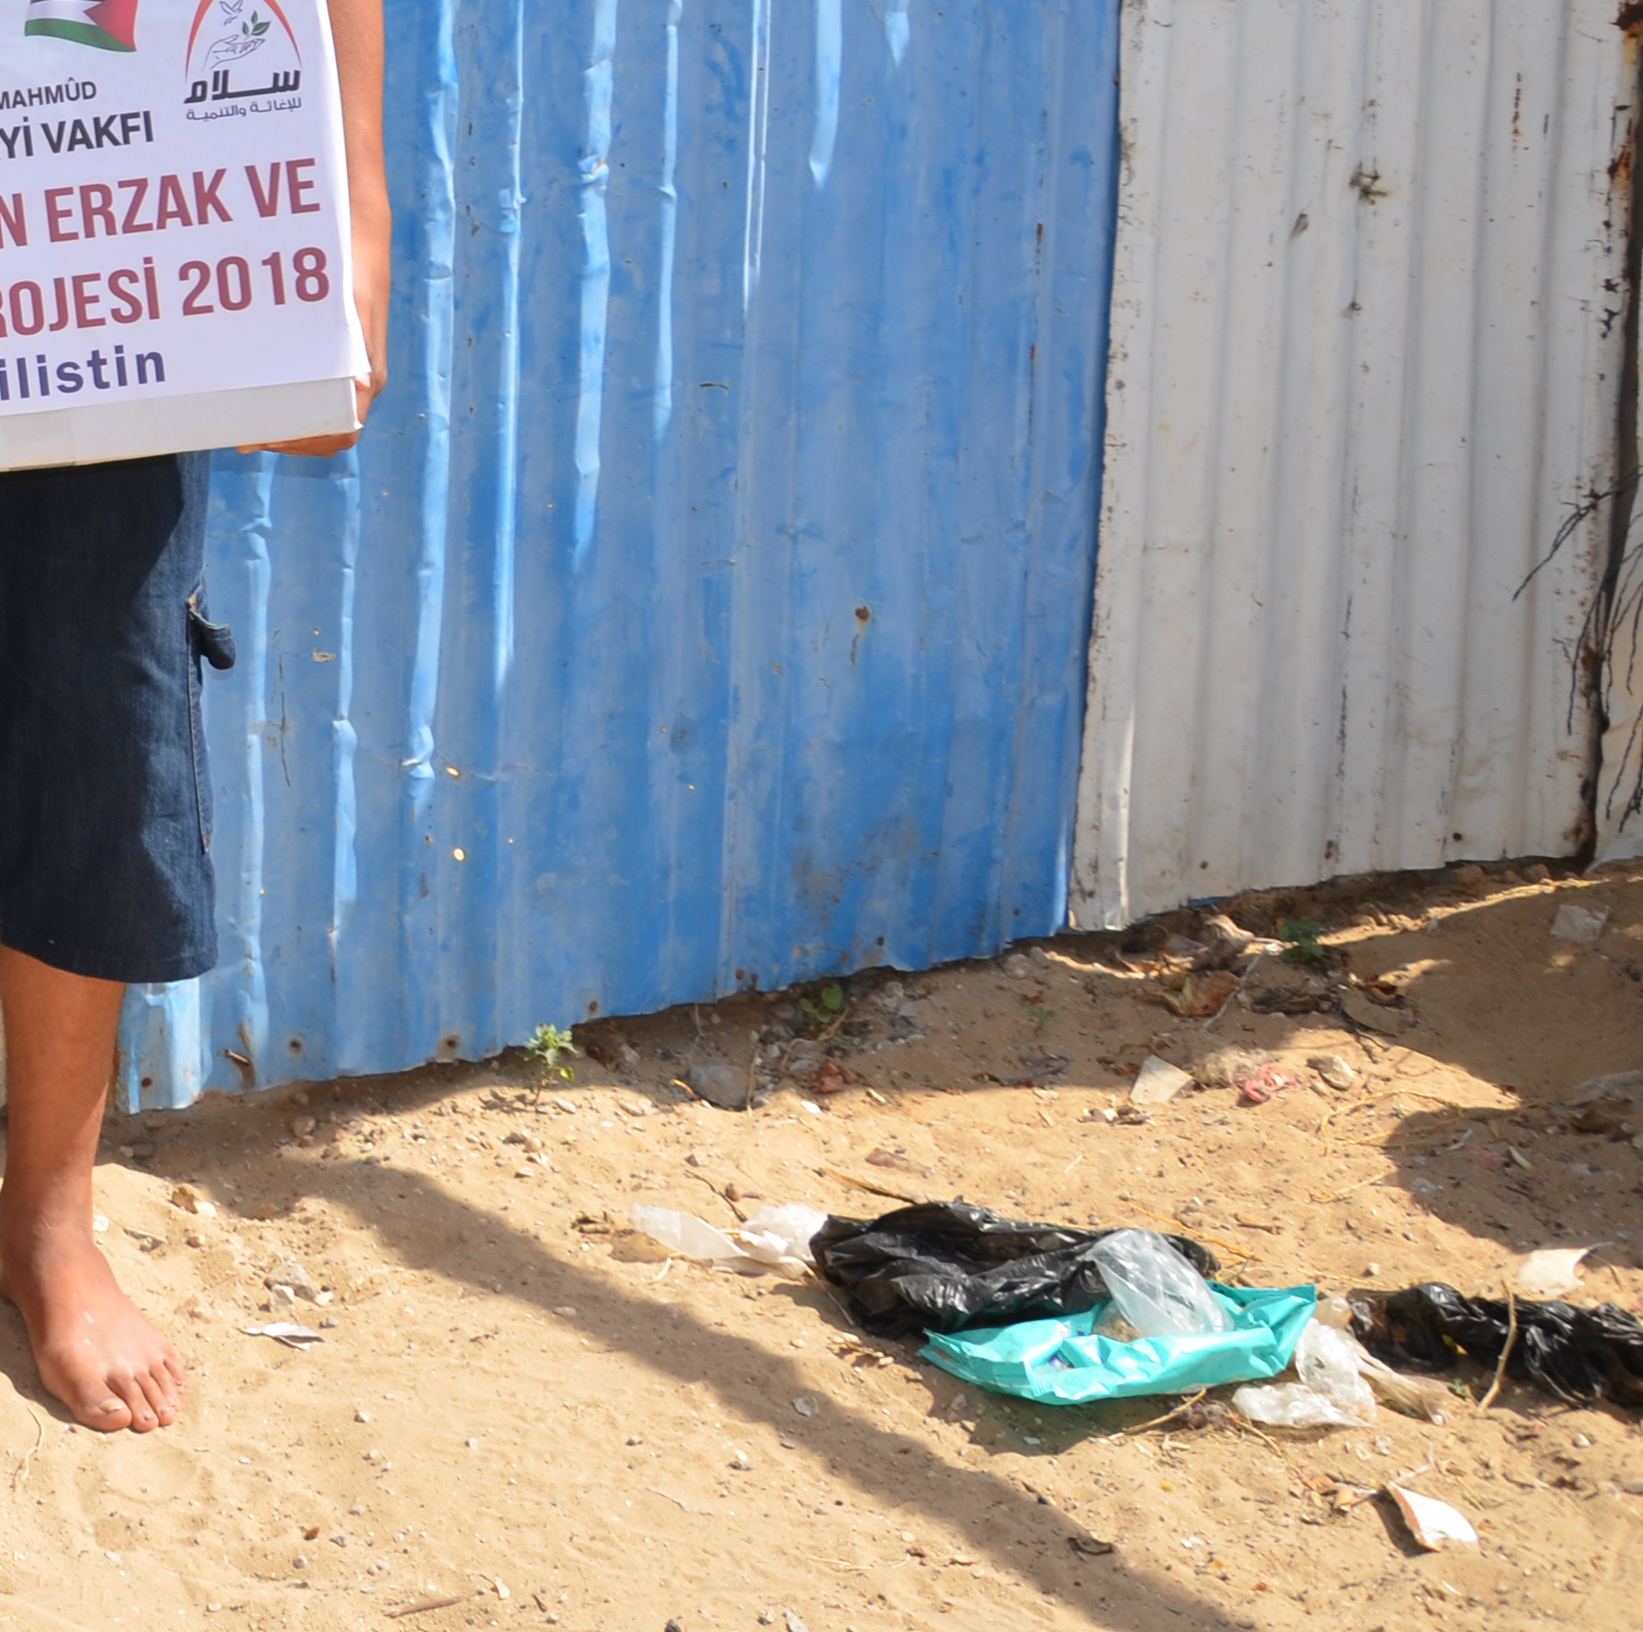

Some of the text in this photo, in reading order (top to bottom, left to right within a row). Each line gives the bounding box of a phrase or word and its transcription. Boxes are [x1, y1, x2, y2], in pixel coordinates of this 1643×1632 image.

[183, 69, 301, 104] سلام
[40, 110, 154, 154] VAKFI
[186, 105, 247, 122] والتنمية
[44, 168, 234, 243] ERZAK
[244, 158, 321, 218] VE
[178, 246, 330, 317] 2018
